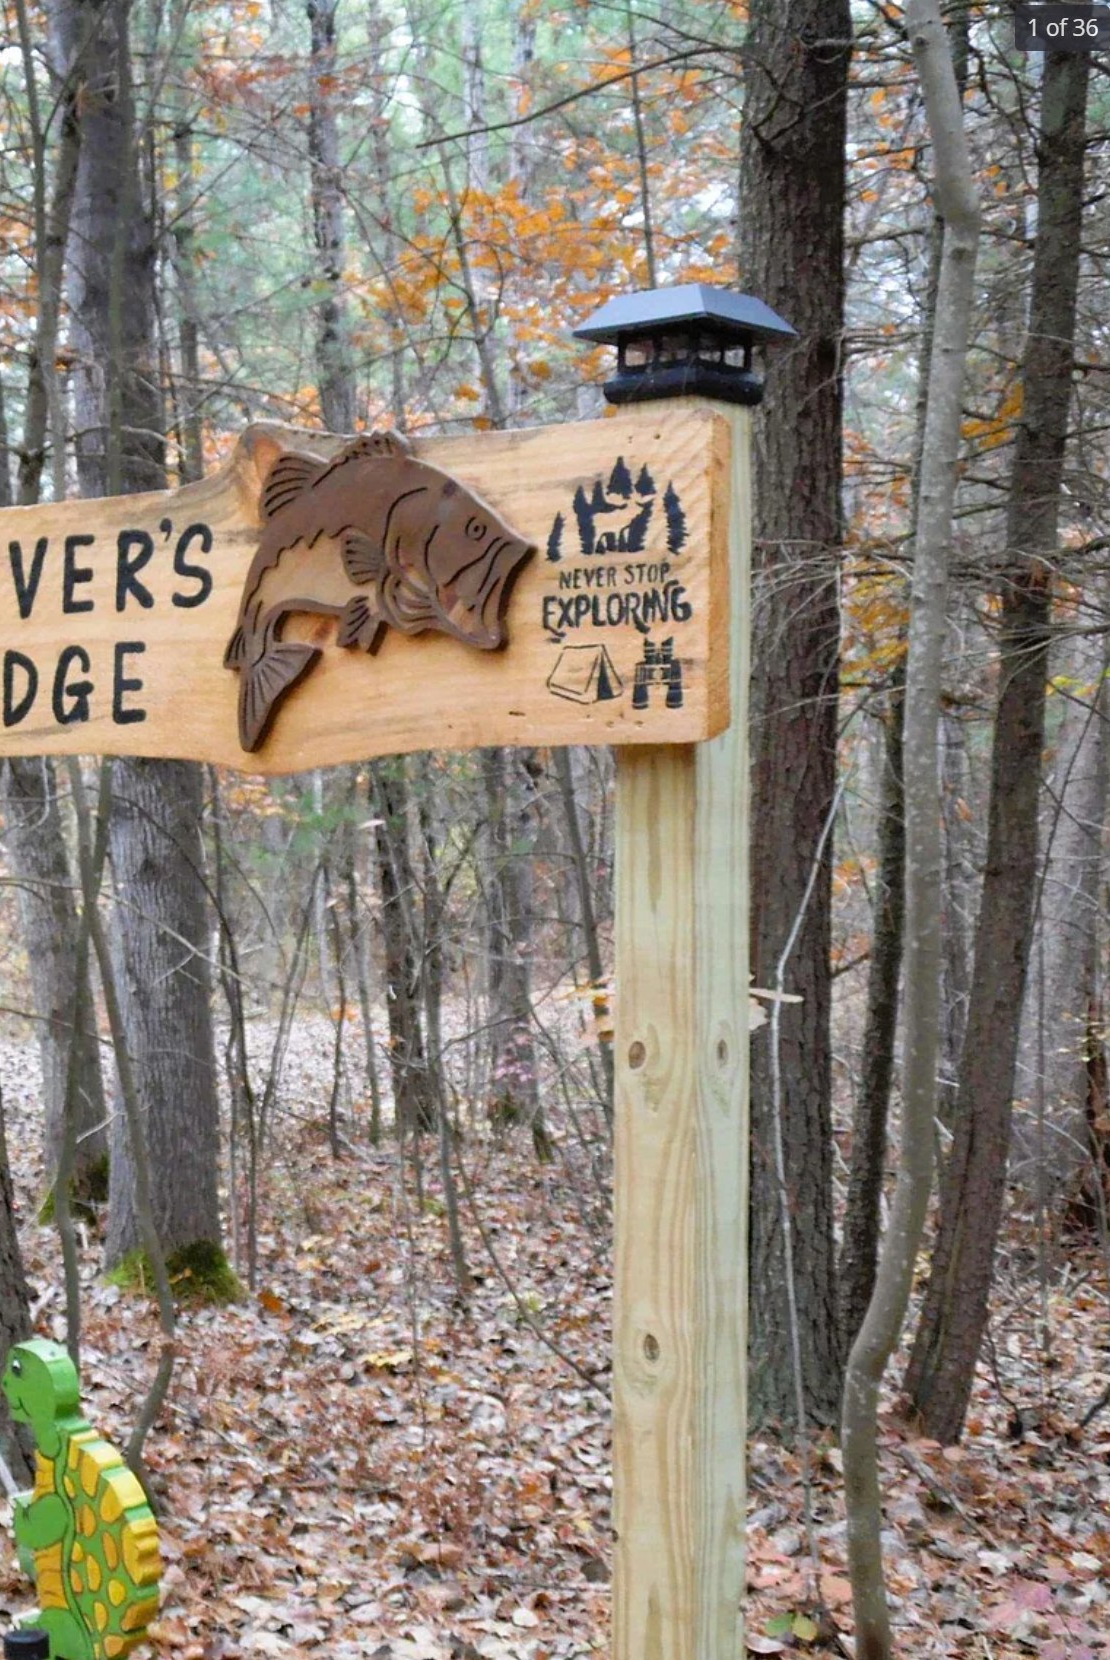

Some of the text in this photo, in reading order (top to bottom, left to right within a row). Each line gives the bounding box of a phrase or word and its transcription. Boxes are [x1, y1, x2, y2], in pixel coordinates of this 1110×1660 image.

[559, 562, 671, 590] NEVER STOP
[543, 579, 692, 637] EXPLORING
